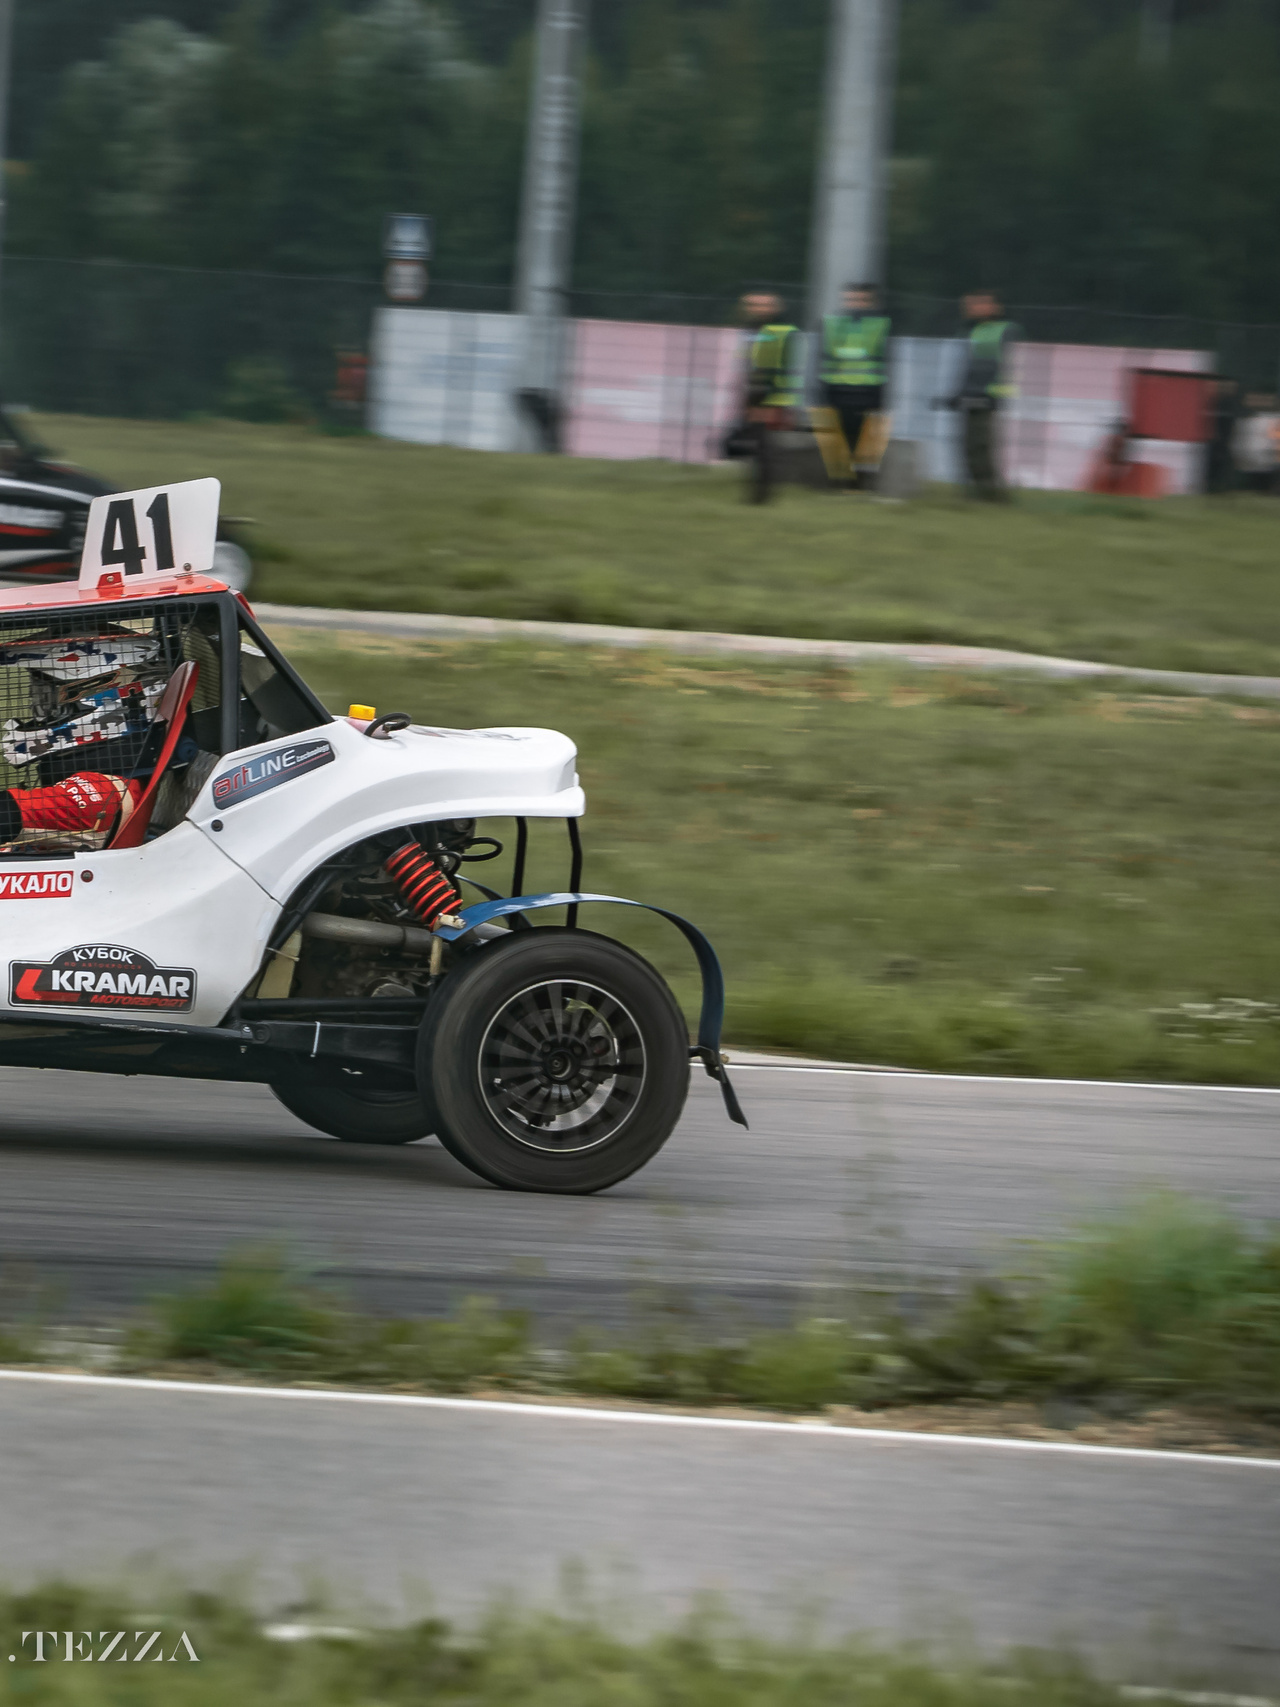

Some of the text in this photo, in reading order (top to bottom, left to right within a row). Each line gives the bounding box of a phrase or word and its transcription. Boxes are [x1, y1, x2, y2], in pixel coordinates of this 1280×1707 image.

[101, 493, 175, 576] 41
[72, 947, 135, 965] КУБОК
[51, 969, 191, 998] KRAMAR
[89, 994, 189, 1008] MOTORSPORT
